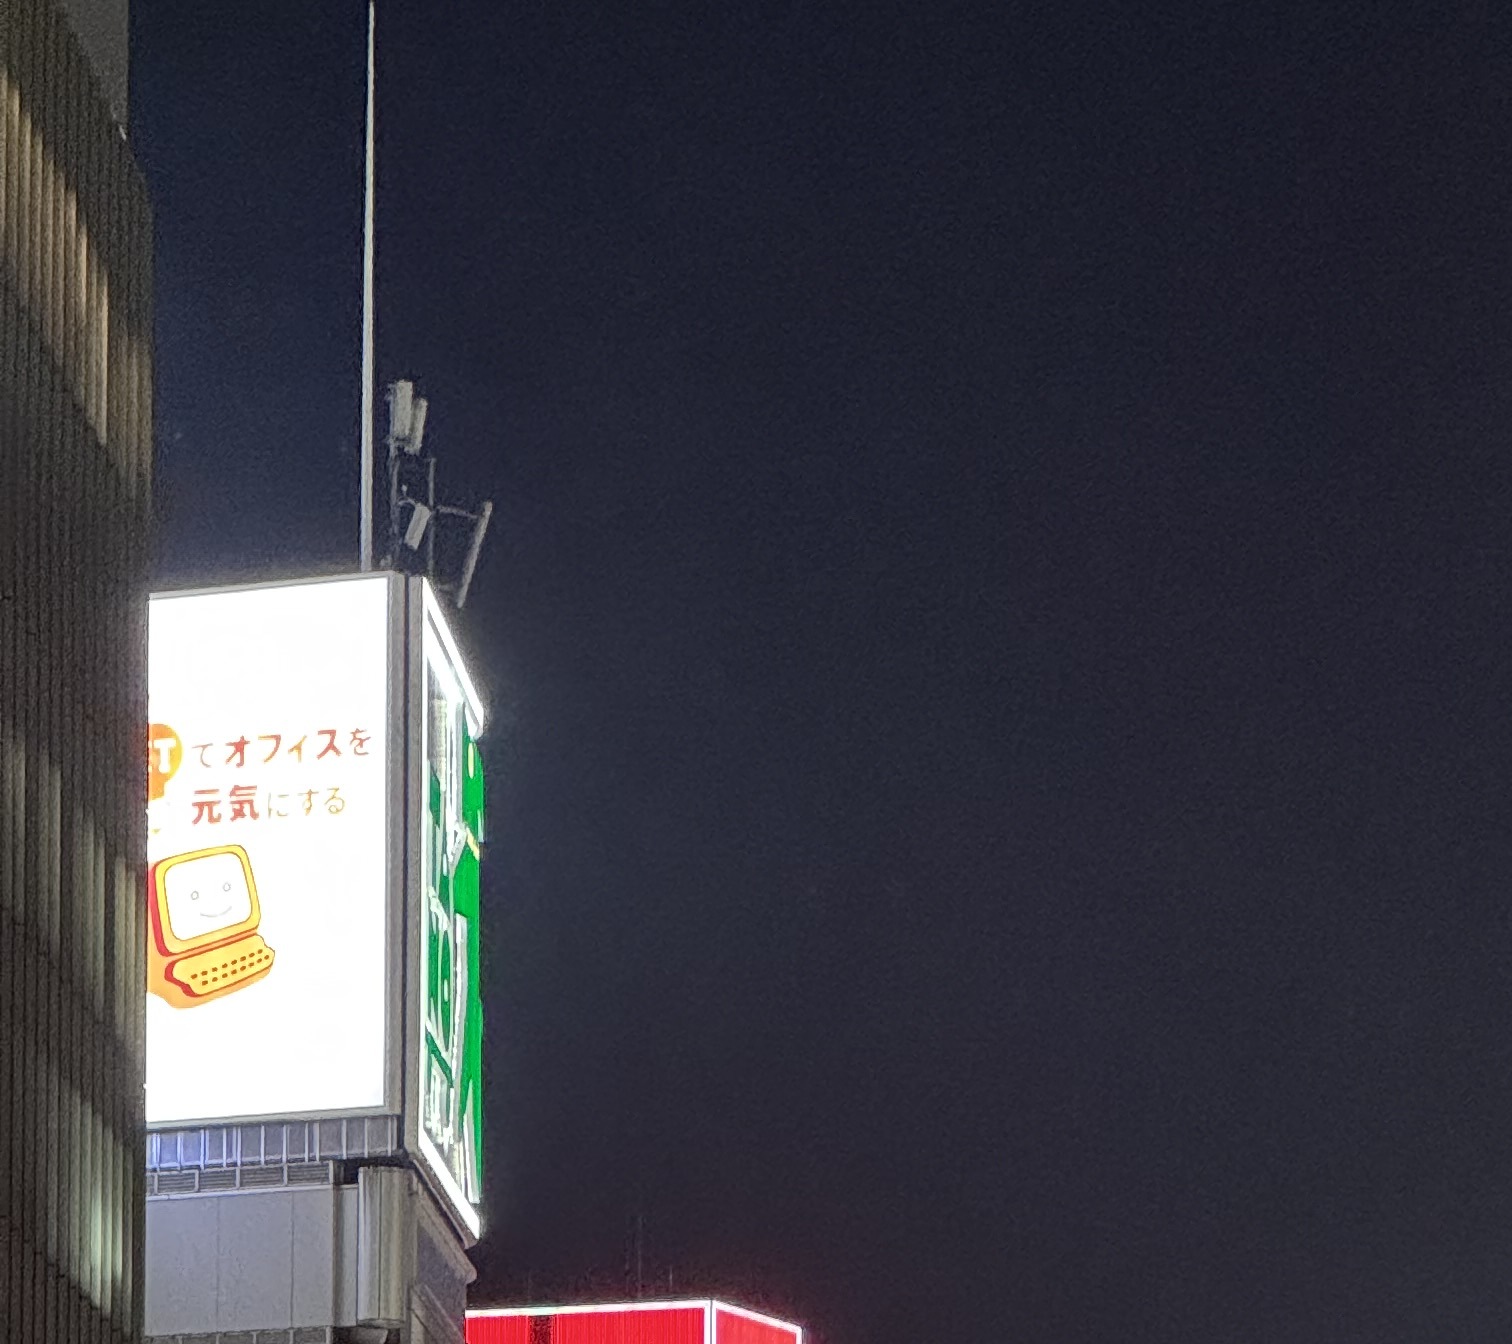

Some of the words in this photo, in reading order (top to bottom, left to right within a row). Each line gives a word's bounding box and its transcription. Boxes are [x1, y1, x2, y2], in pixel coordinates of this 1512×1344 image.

[191, 784, 346, 825] 元気にする
